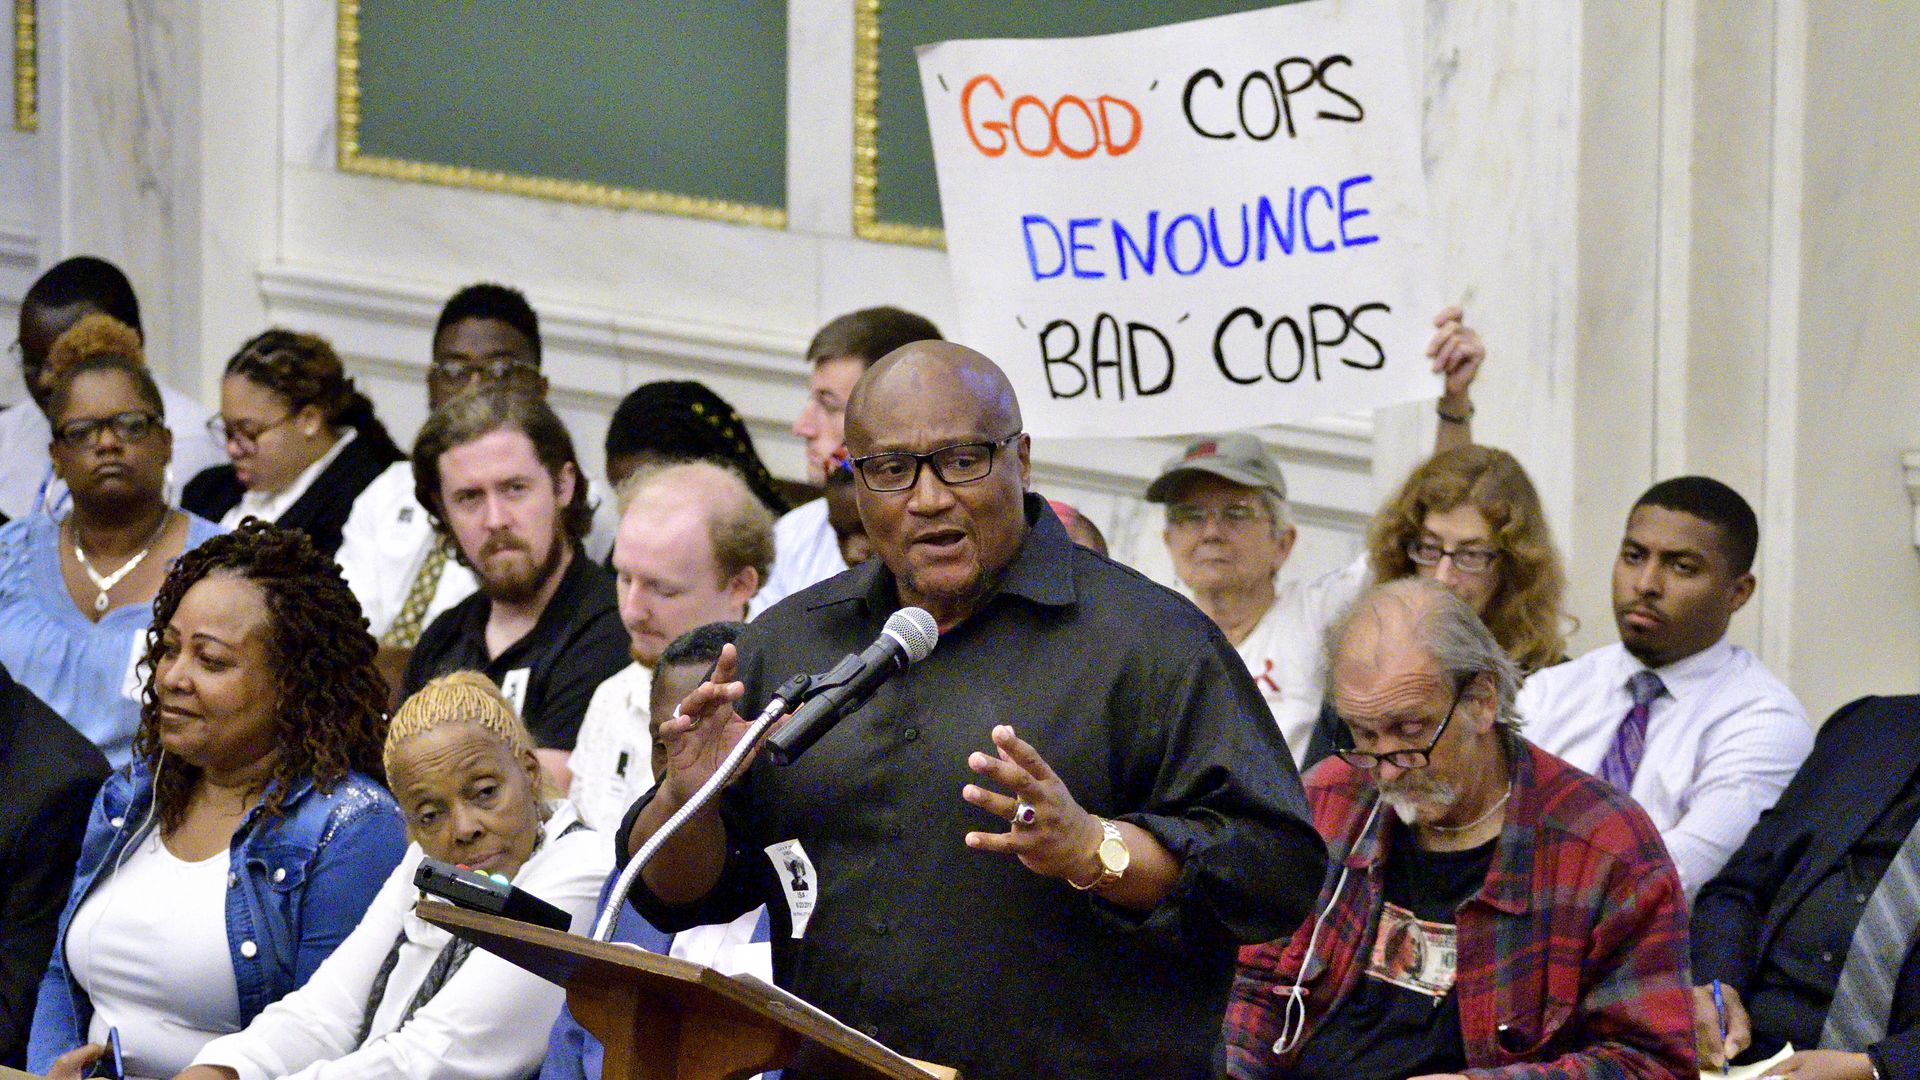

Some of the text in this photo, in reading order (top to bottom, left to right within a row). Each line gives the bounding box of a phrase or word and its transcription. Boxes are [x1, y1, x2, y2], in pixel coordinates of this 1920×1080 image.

[1182, 55, 1364, 141] COPS
[1022, 175, 1380, 281] DENOUNCE
[1213, 302, 1391, 385] COPS
